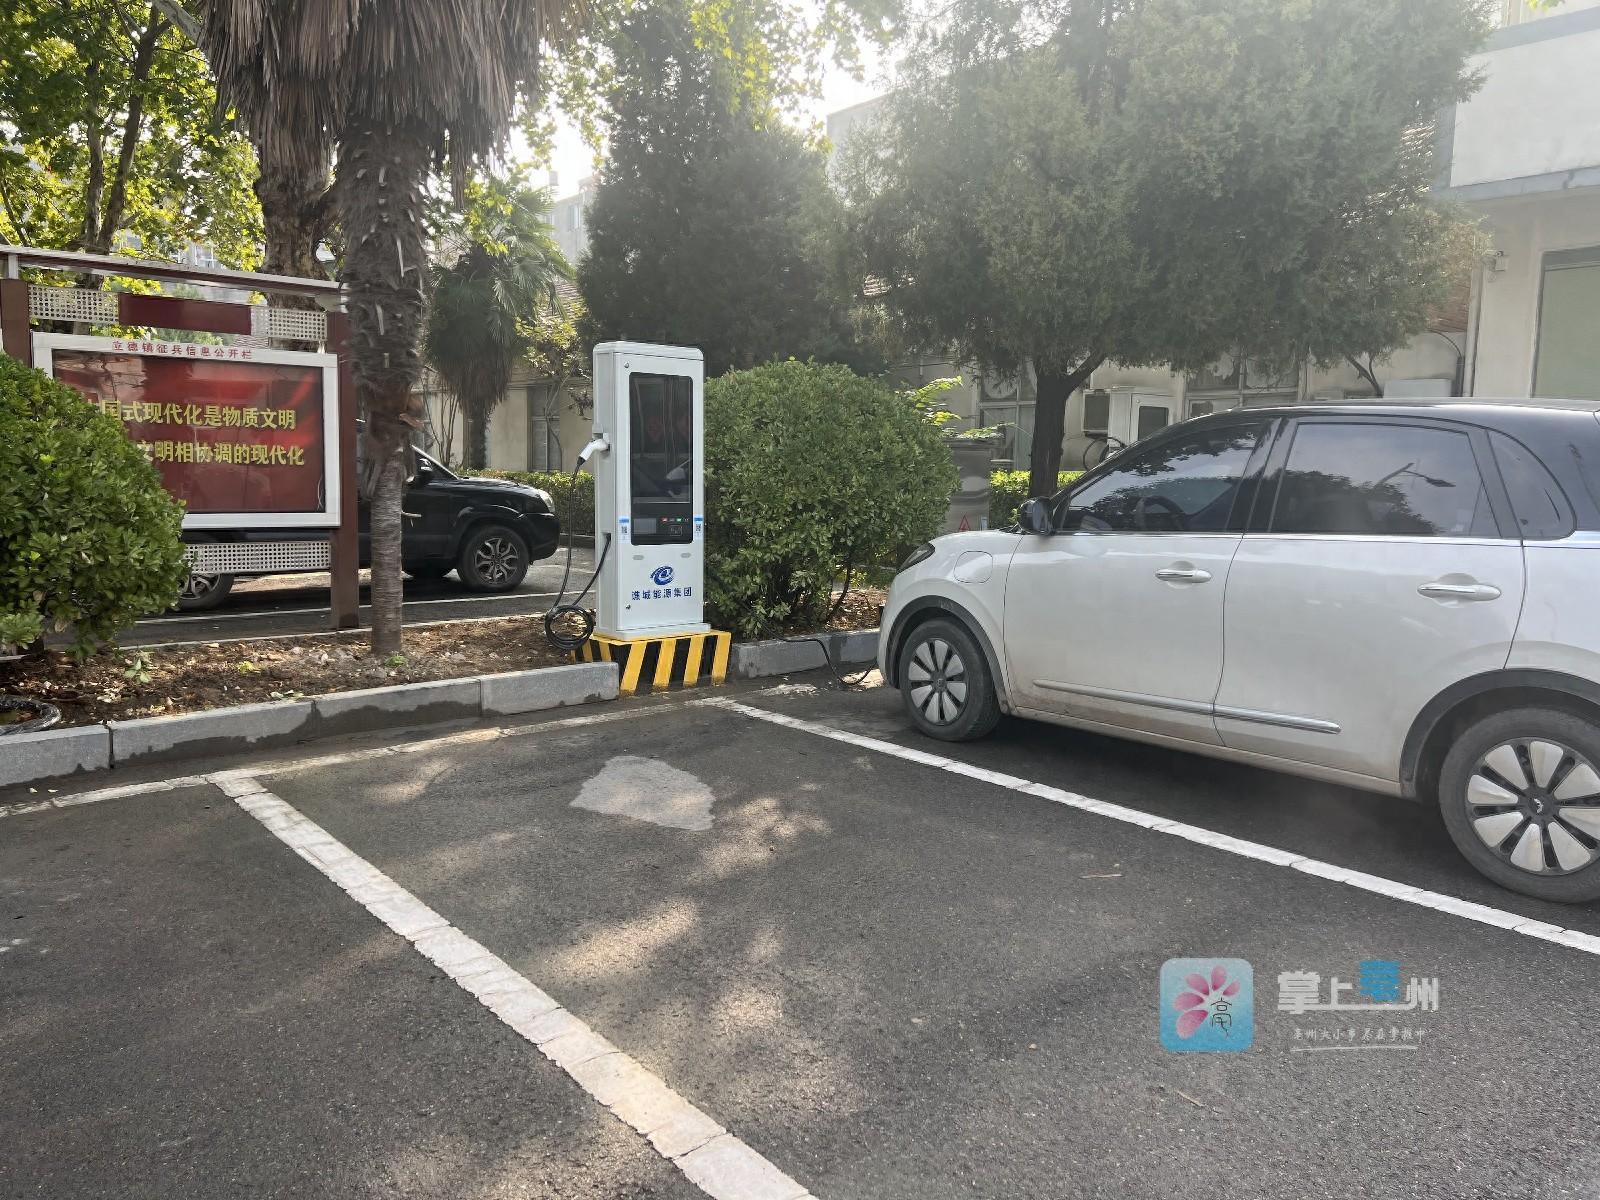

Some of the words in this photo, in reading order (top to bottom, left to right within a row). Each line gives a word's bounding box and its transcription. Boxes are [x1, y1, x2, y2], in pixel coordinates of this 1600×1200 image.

[88, 399, 297, 430] 国式现代化是物质文明
